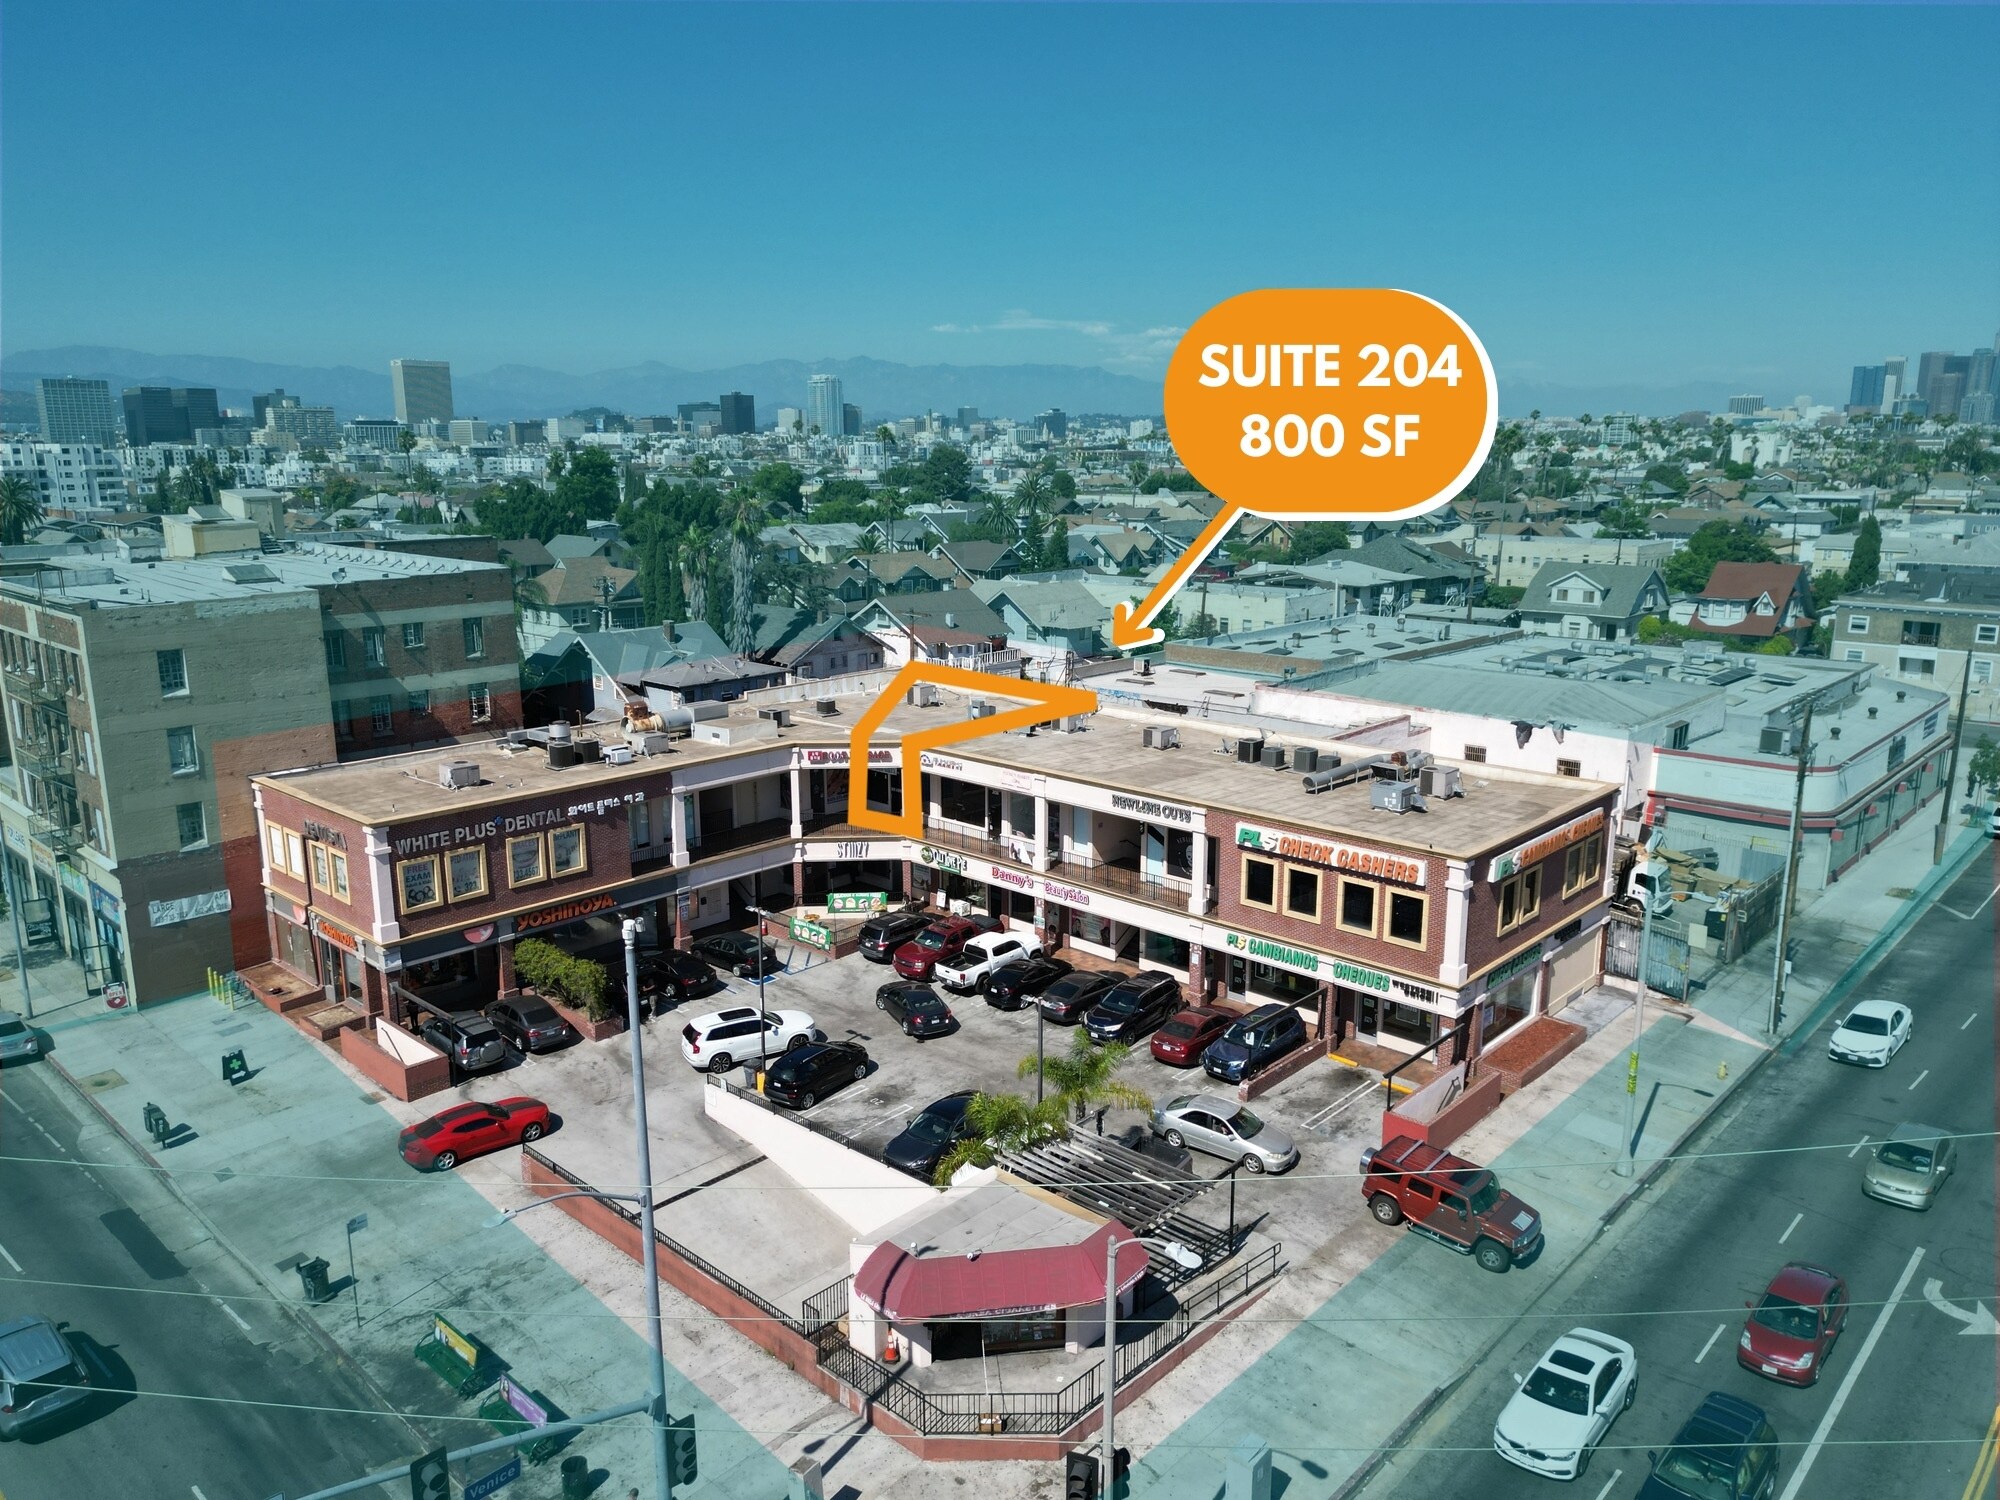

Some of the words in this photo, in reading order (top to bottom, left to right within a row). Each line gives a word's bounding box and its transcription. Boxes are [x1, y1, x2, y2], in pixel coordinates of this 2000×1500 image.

[1162, 805, 1191, 824] CUTS
[395, 830, 450, 855] WHITE
[454, 821, 497, 843] PLUS
[505, 807, 566, 833] DENTAL
[407, 862, 429, 875] FREE
[1279, 836, 1335, 865] CHECK
[1337, 848, 1419, 884] CASHERS
[406, 871, 432, 883] EXAM
[992, 866, 1034, 889] Danny's
[1248, 938, 1319, 972] CAMBIAMOS
[1333, 962, 1390, 992] CHEQUES
[470, 1466, 516, 1499] Venice
